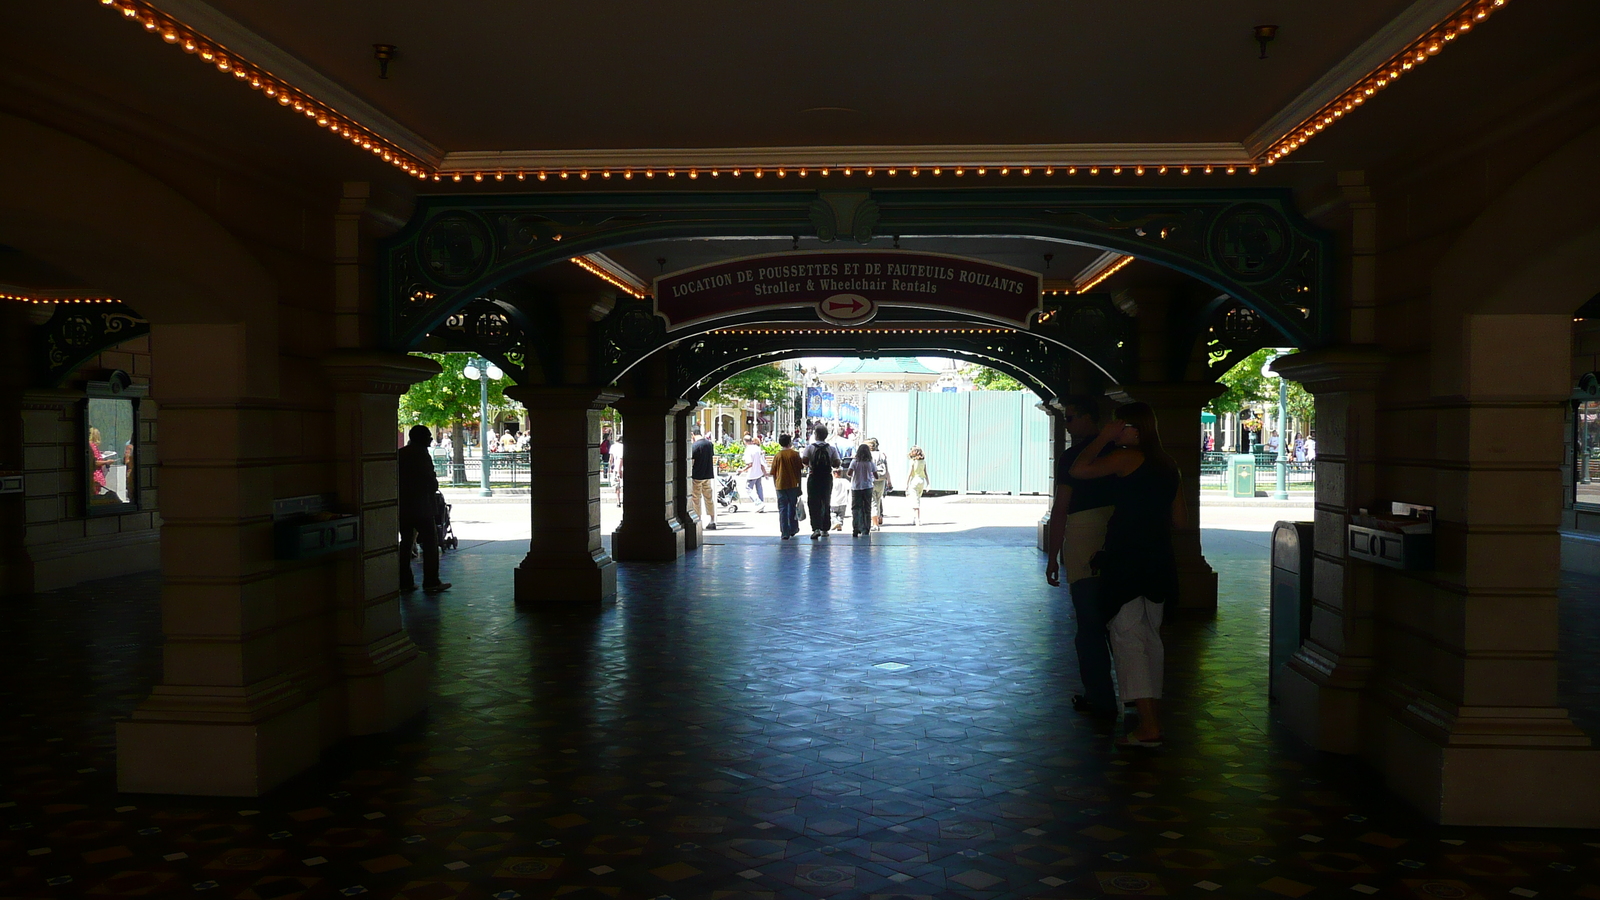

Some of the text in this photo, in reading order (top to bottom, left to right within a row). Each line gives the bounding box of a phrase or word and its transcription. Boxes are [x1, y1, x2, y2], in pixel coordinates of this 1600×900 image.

[672, 263, 1024, 298] LOCATION DE POUSSETTES ET DE FAUTEUILS ROULANTS
[754, 278, 937, 296] Stroller & Wheelchair Rentals
